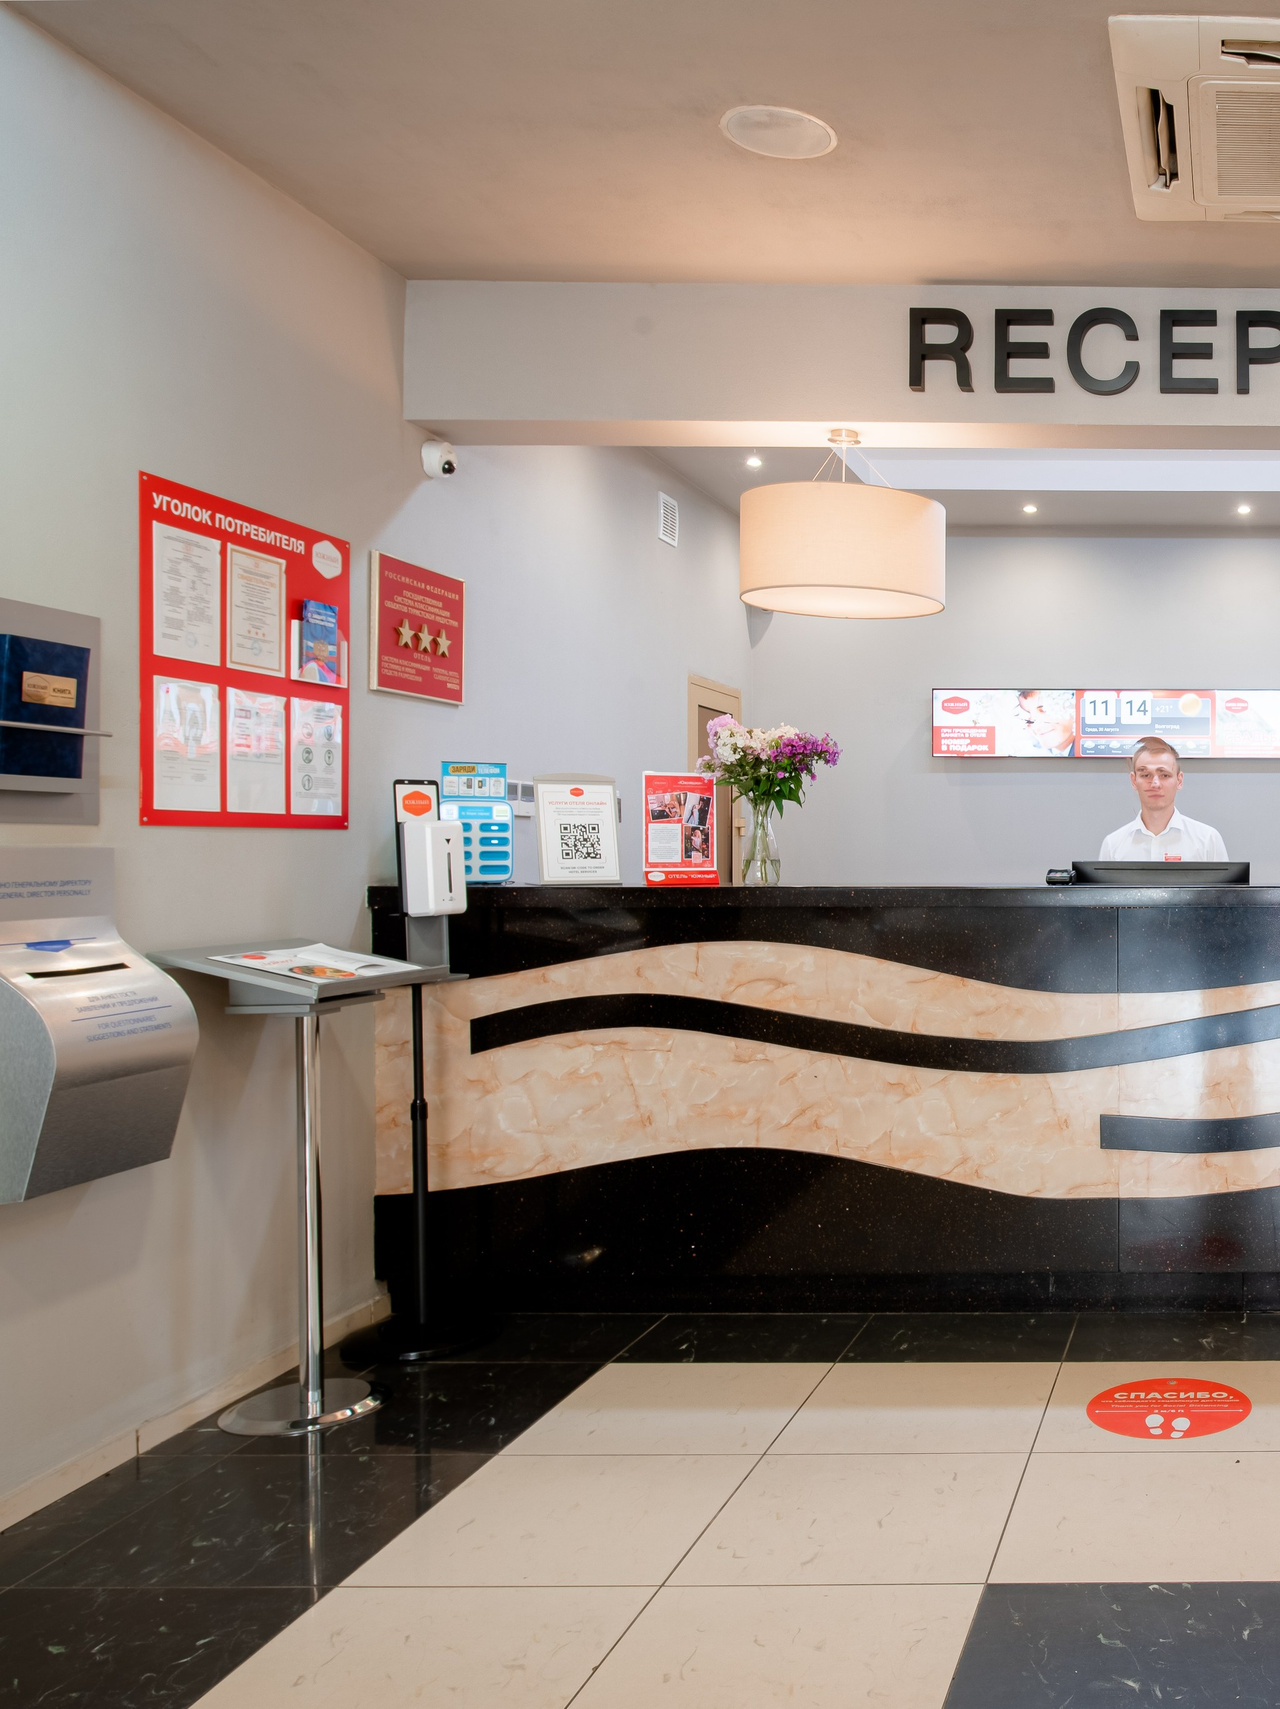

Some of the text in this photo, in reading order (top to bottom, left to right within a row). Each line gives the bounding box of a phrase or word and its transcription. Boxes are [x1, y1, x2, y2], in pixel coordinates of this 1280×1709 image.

[153, 492, 305, 555] УГОЛОК ПОТРЕБИТЕЛЯ
[385, 571, 459, 600] РОССИЙСКАЯ ФЕДЕРАЦИЯ
[413, 652, 431, 662] ОТЕЛЬ
[1089, 700, 1108, 716] 11
[1125, 700, 1148, 716] 14
[1155, 705, 1173, 713] +21°
[451, 765, 476, 773] ЗАРЯДИ
[26, 890, 55, 898] DIRECTOR
[87, 1022, 172, 1042] SUGGESTIONS AND STATEMENTS
[1114, 1391, 1234, 1400] СПАСИБО,
